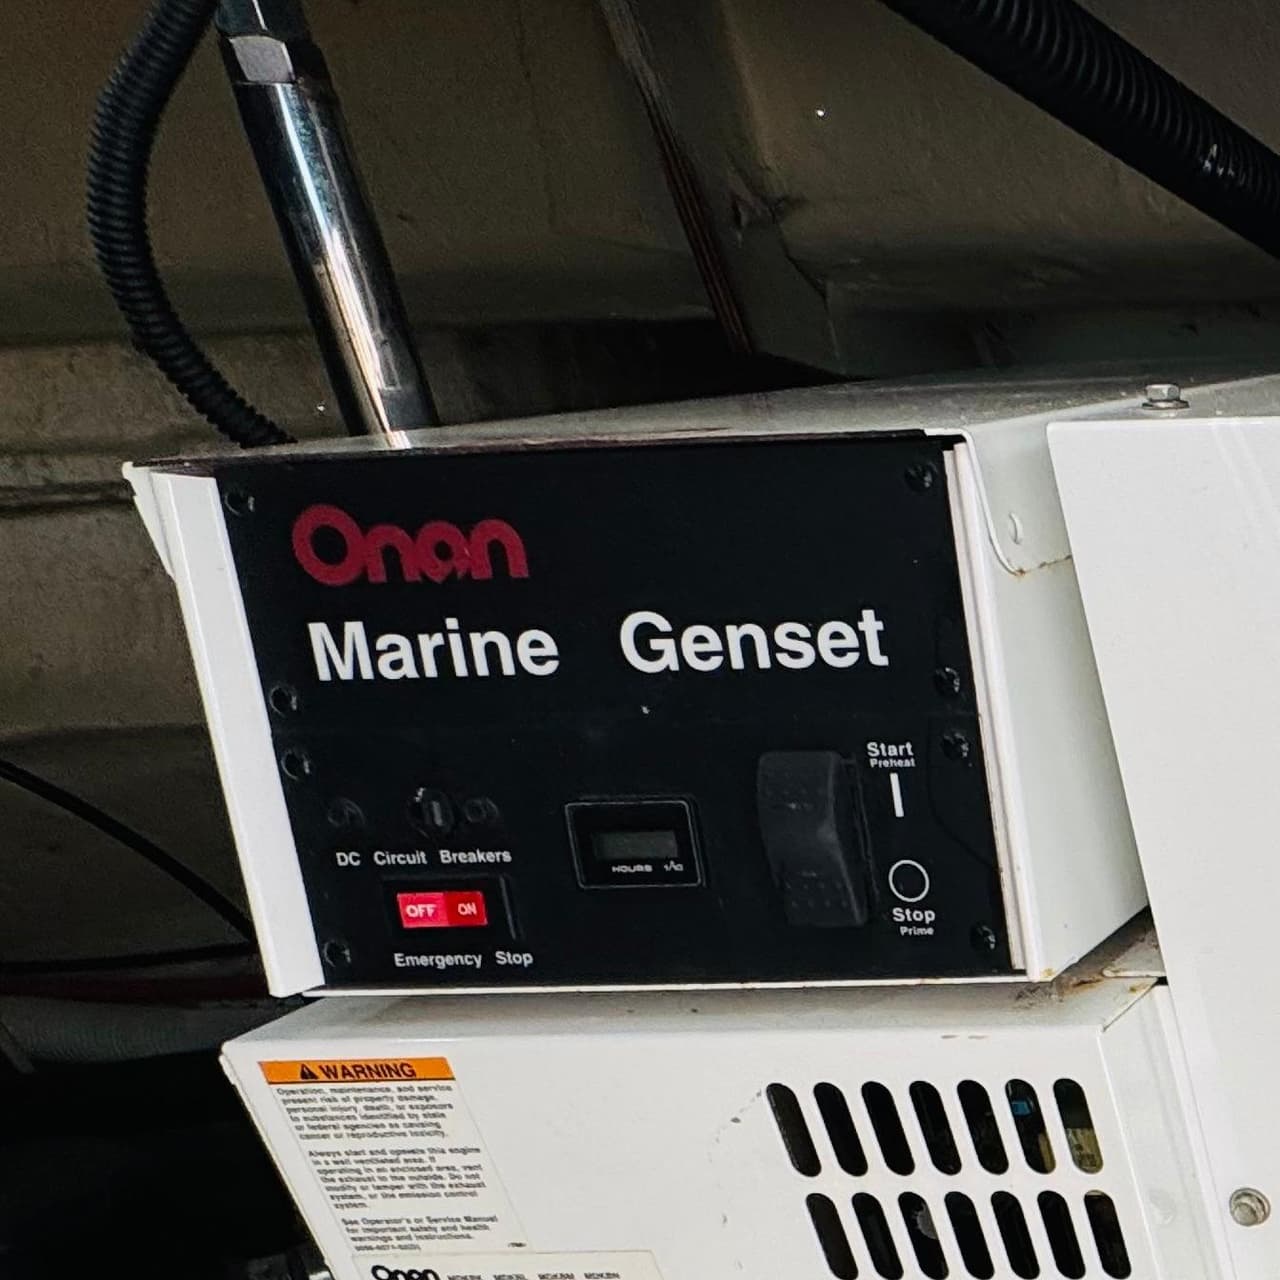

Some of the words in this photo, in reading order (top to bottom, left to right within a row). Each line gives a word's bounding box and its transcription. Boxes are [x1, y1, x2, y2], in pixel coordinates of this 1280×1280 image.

[291, 503, 529, 586] Onan
[307, 618, 560, 682] Marine
[619, 609, 889, 675] Genset
[866, 742, 914, 757] Start
[869, 758, 916, 768] Preheat
[335, 851, 361, 866] DC
[373, 850, 428, 865] Circuit
[439, 849, 512, 864] Breakers
[406, 903, 436, 917] OFF
[457, 902, 477, 915] ON
[892, 907, 936, 924] Stop
[900, 926, 935, 937] Prime
[394, 952, 482, 970] Emergency
[495, 951, 533, 967] Stop
[318, 1062, 417, 1081] WARNING
